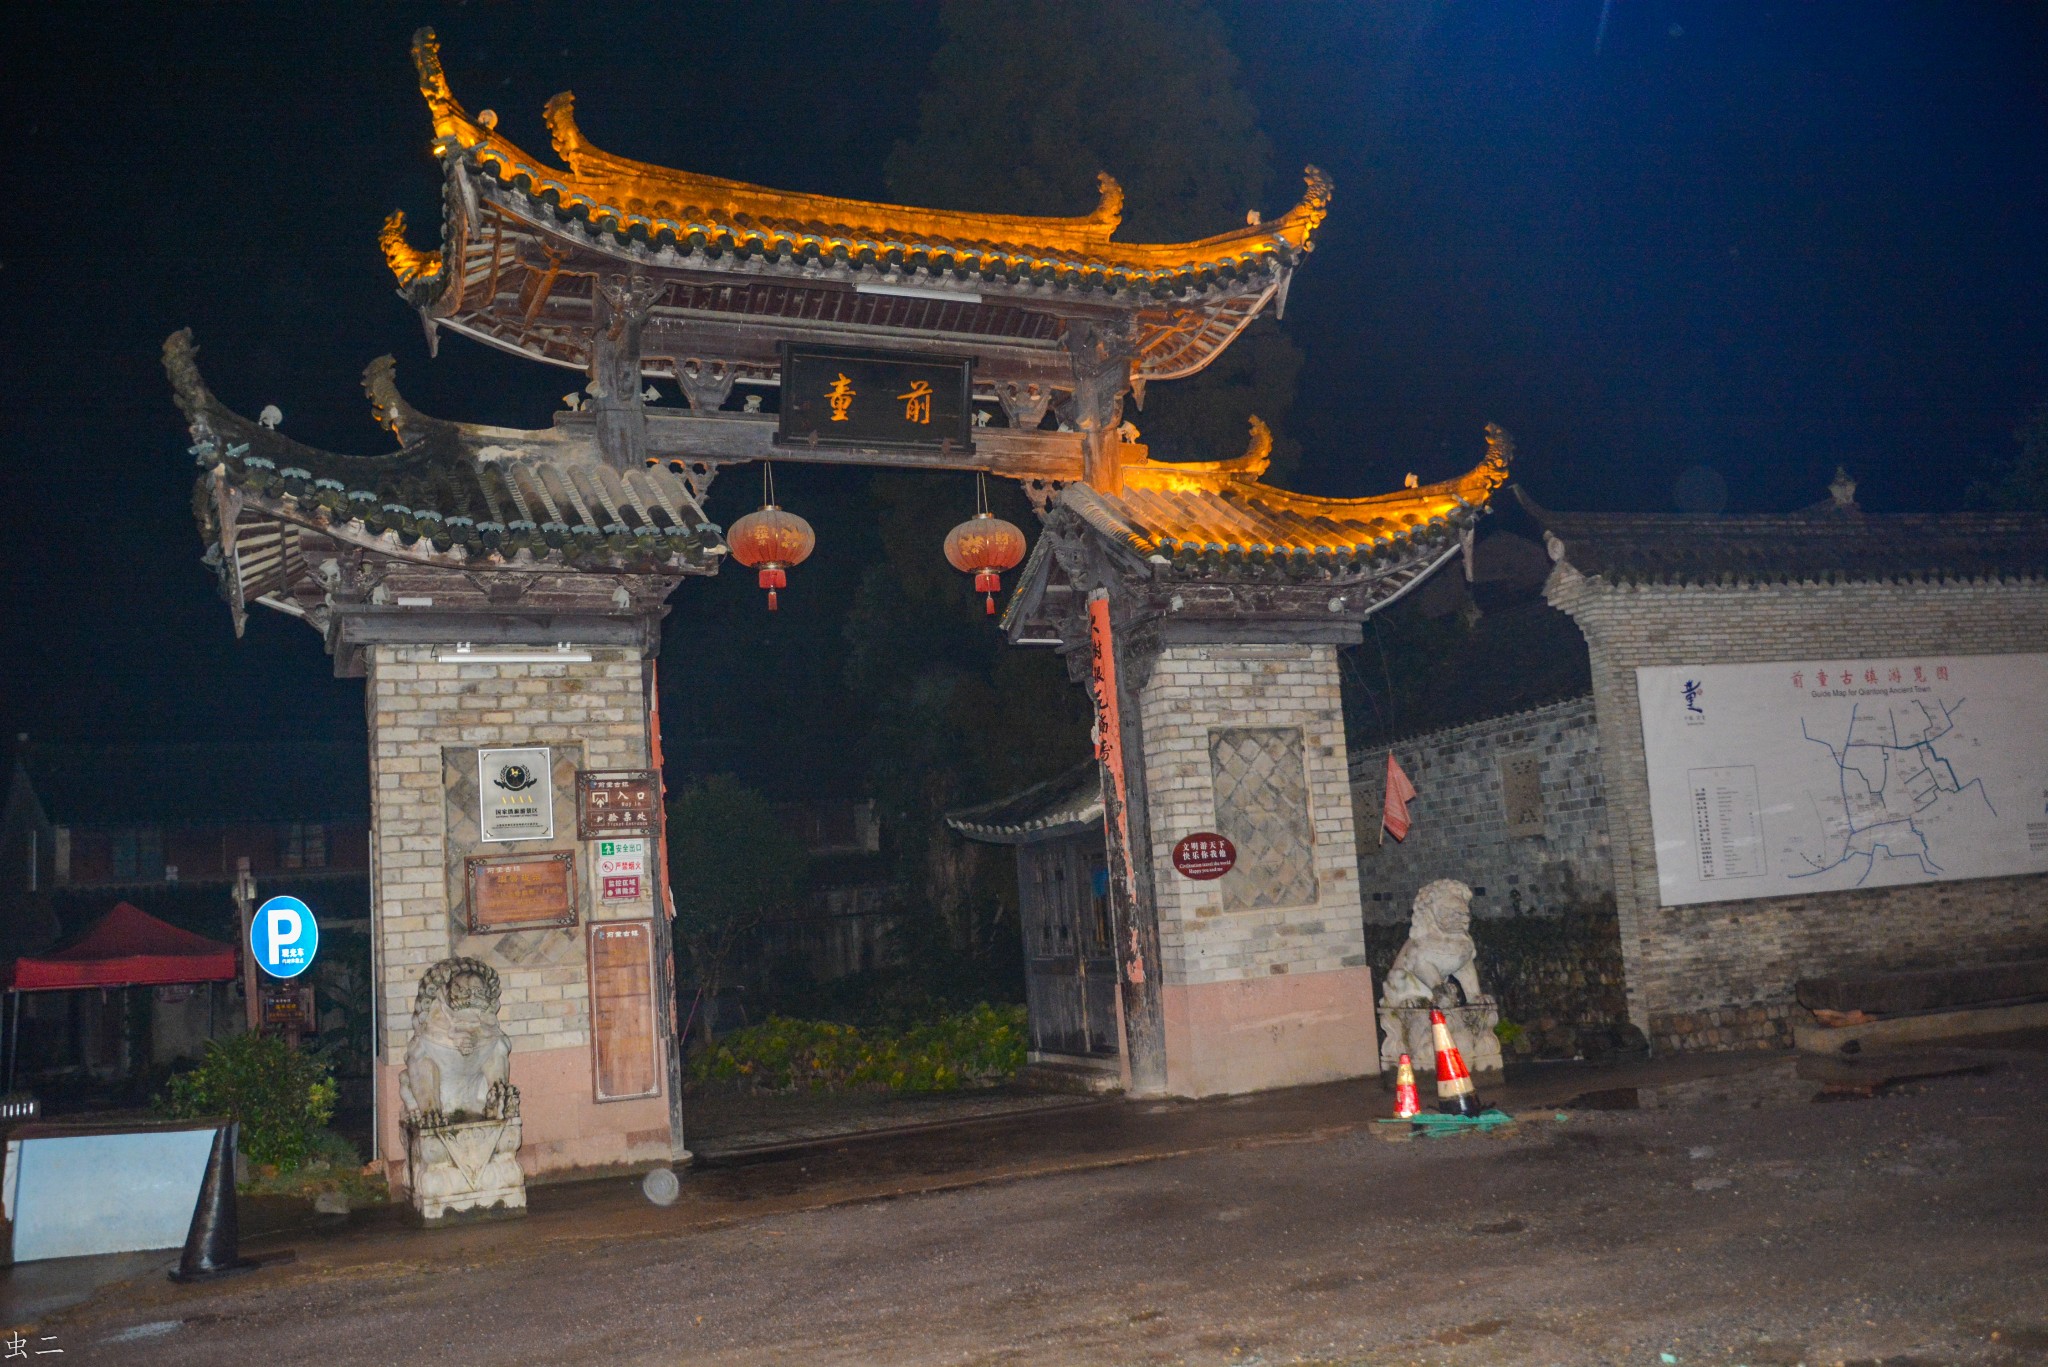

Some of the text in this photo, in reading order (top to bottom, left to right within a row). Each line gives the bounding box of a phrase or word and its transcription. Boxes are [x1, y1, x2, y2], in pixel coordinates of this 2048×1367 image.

[1811, 690, 1831, 698] Guide
[1832, 689, 1847, 698] Map
[1848, 688, 1857, 696] for
[1889, 687, 1913, 695] Ancient
[1914, 685, 1931, 693] Town
[617, 790, 645, 800] 入口
[607, 811, 648, 822] 验票处
[615, 843, 642, 853] 安全出口
[1183, 840, 1224, 851] 文明游天下
[1183, 849, 1226, 860] 快乐你我他
[615, 860, 642, 871] 严禁烟火
[608, 879, 637, 888] 监控区域
[267, 908, 302, 965] P
